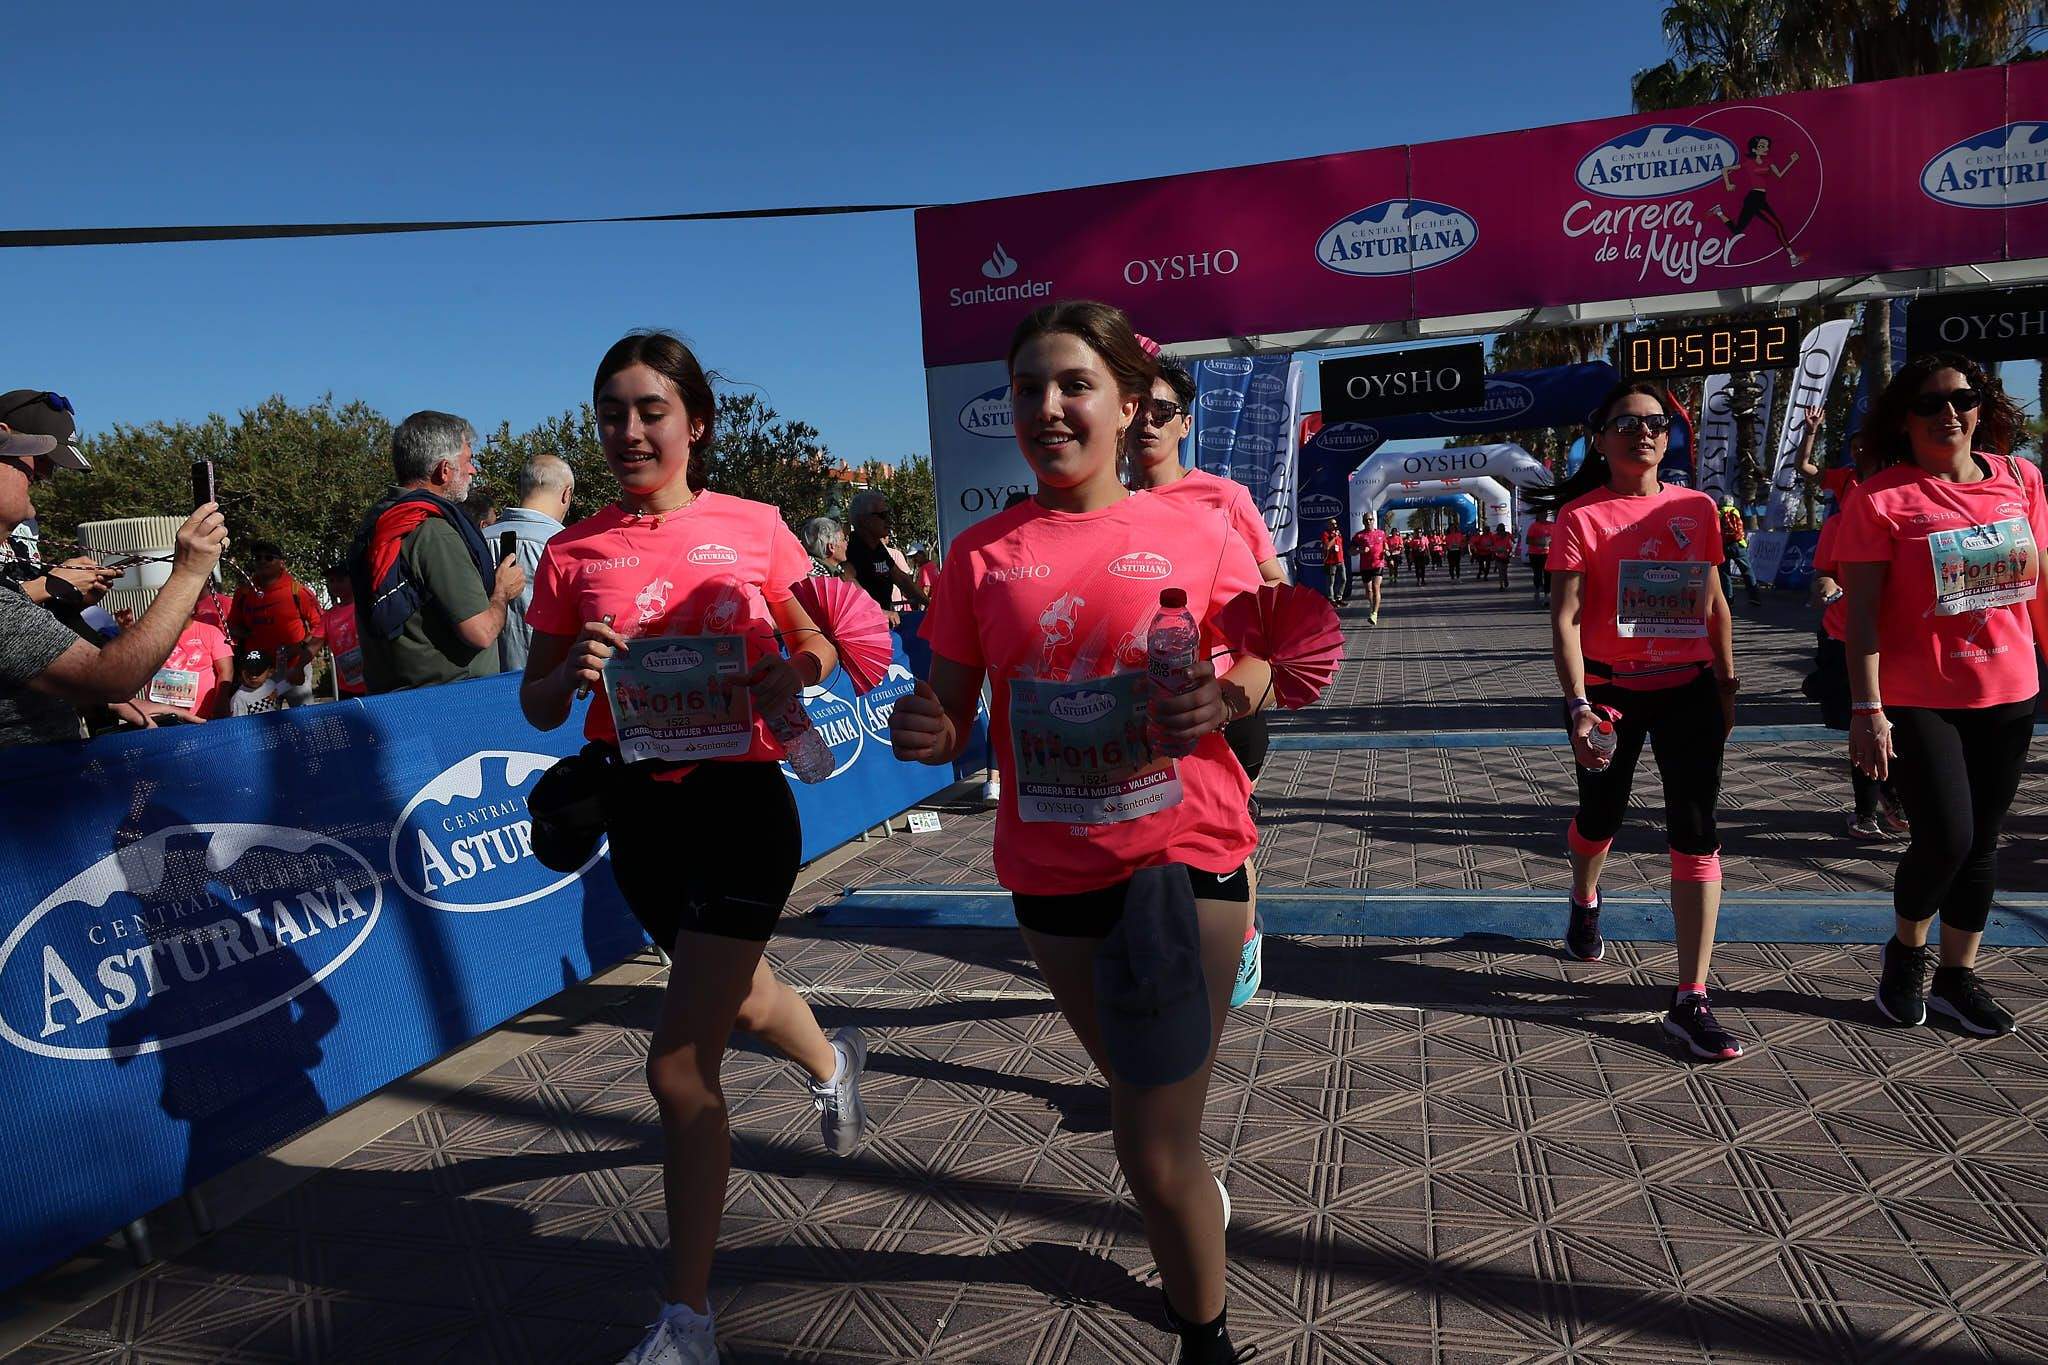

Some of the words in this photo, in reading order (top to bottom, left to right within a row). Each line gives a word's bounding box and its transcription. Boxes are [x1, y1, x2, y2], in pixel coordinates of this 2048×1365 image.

[1611, 151, 1664, 162] CENTRAL
[1667, 143, 1721, 157] LECHERA
[1587, 153, 1725, 186] ASTURIANA
[1935, 161, 2048, 193] ASTURI
[1351, 226, 1402, 238] CENTRAL
[1562, 200, 1695, 238] Carrera
[1328, 229, 1466, 262] ASTURIANA
[1594, 236, 1619, 263] de
[1624, 233, 1642, 260] la
[1638, 222, 1746, 285] Mujer
[1123, 249, 1239, 285] OYSHO
[950, 279, 1053, 308] Santander
[1939, 309, 2048, 343] OYSH
[1632, 326, 1787, 372] 00:58:32
[1346, 367, 1461, 400] OYSHO
[1404, 452, 1487, 474] OYSHO
[586, 556, 640, 574] OYSHO
[987, 564, 1050, 585] OYSHO
[1113, 561, 1168, 575] ASTURIANA
[1968, 560, 2006, 578] 016
[645, 656, 700, 668] ASTURIANA
[652, 690, 705, 713] 016
[1053, 700, 1113, 717] ASTURIANA
[654, 730, 664, 738] DE
[664, 729, 674, 738] LA
[675, 727, 700, 738] MUJER
[708, 723, 744, 734] VALENCIA
[666, 717, 690, 727] 1523
[814, 716, 860, 748] RIANA
[1063, 742, 1121, 768] 016
[1026, 785, 1062, 796] CARRERA
[1065, 786, 1076, 796] DE
[1078, 786, 1090, 797] LA
[1091, 785, 1121, 798] MUJER
[1128, 771, 1168, 790] VALENCIA
[1080, 774, 1108, 785] 1524
[442, 800, 519, 832] CENTRAL
[1036, 802, 1085, 814] OYSHO
[1117, 793, 1165, 812] Santander
[1070, 826, 1089, 837] 2024
[415, 820, 535, 894] ASTUR
[88, 889, 220, 945] CENTRAL
[229, 853, 338, 901] LECHERA
[39, 877, 368, 1038] ASTURIANA
